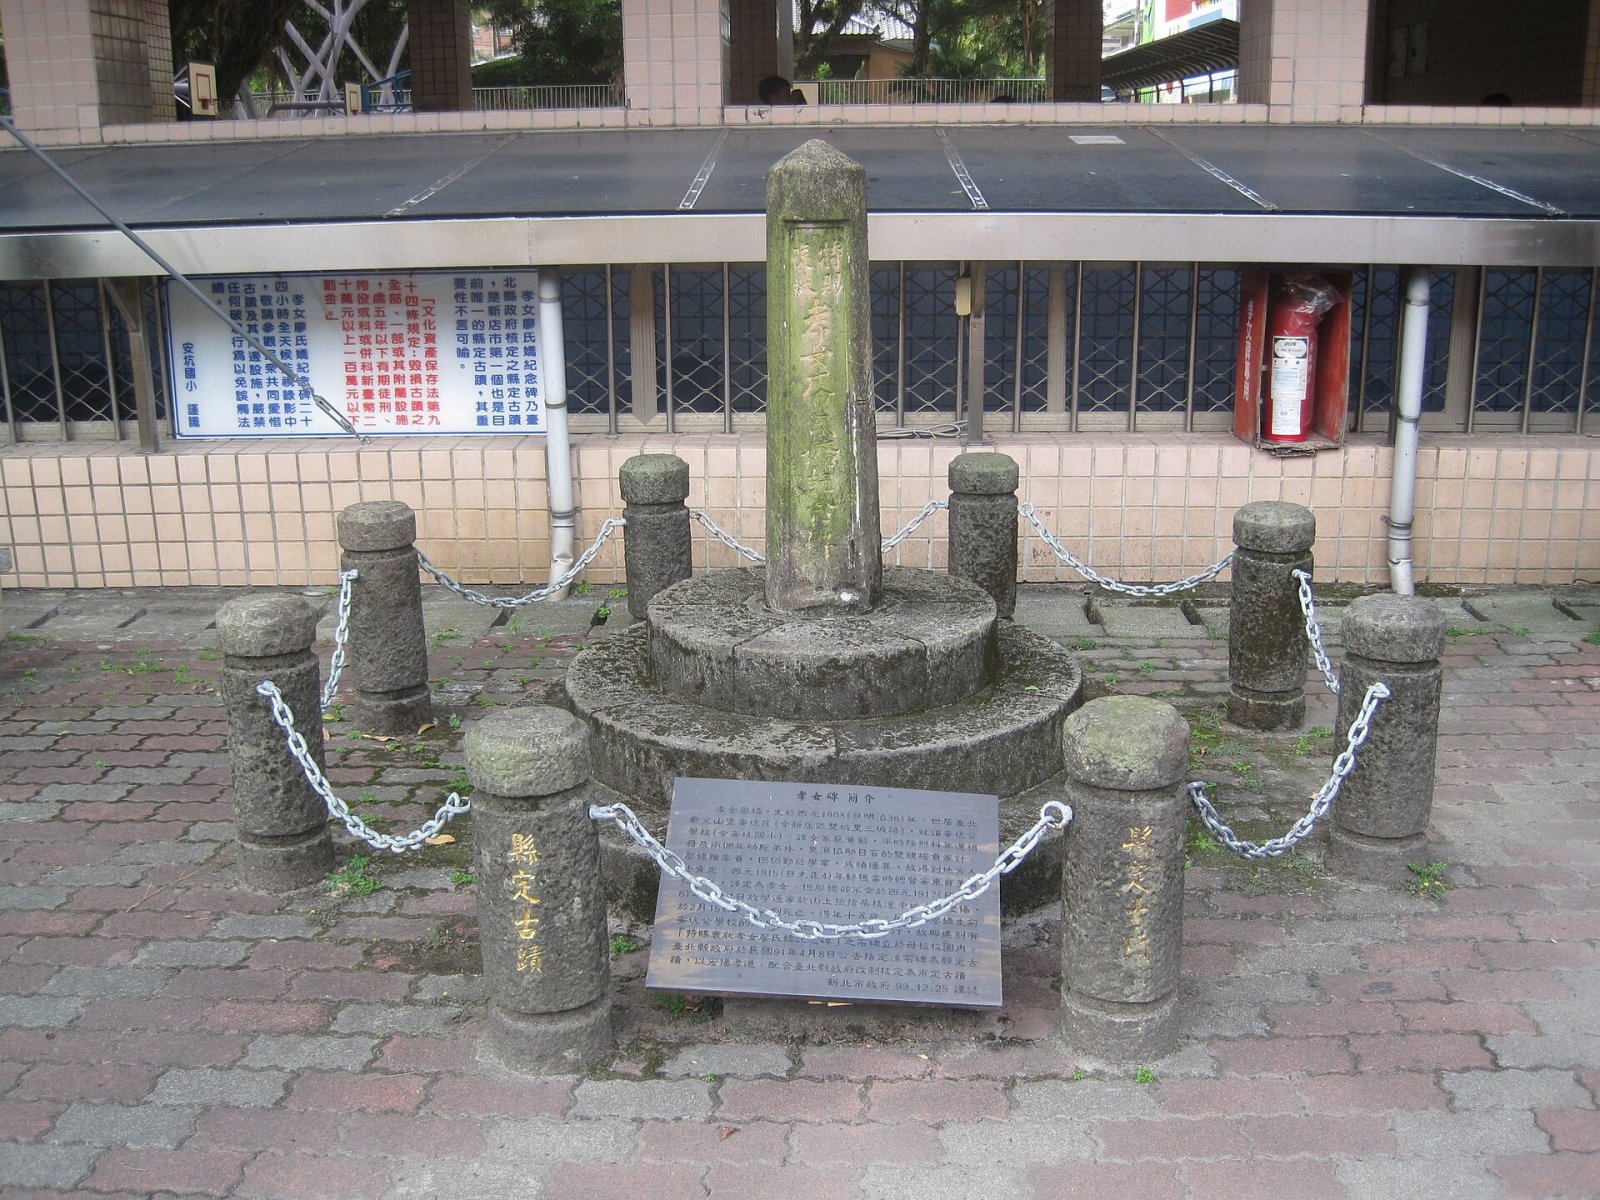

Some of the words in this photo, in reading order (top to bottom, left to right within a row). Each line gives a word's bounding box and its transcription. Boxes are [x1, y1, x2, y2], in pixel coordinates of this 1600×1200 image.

[182, 341, 198, 392] 安坑國小
[503, 277, 522, 426] 北縣政府核定之縣定古蹟
[521, 289, 539, 426] 孝女廖氏嬌紀念碑乃臺
[795, 789, 839, 802] 孝女碑
[848, 792, 875, 804] 簡介
[508, 832, 543, 974] 縣定古蹟
[827, 977, 891, 991] 新北市政府
[895, 981, 948, 994] 99.12.25
